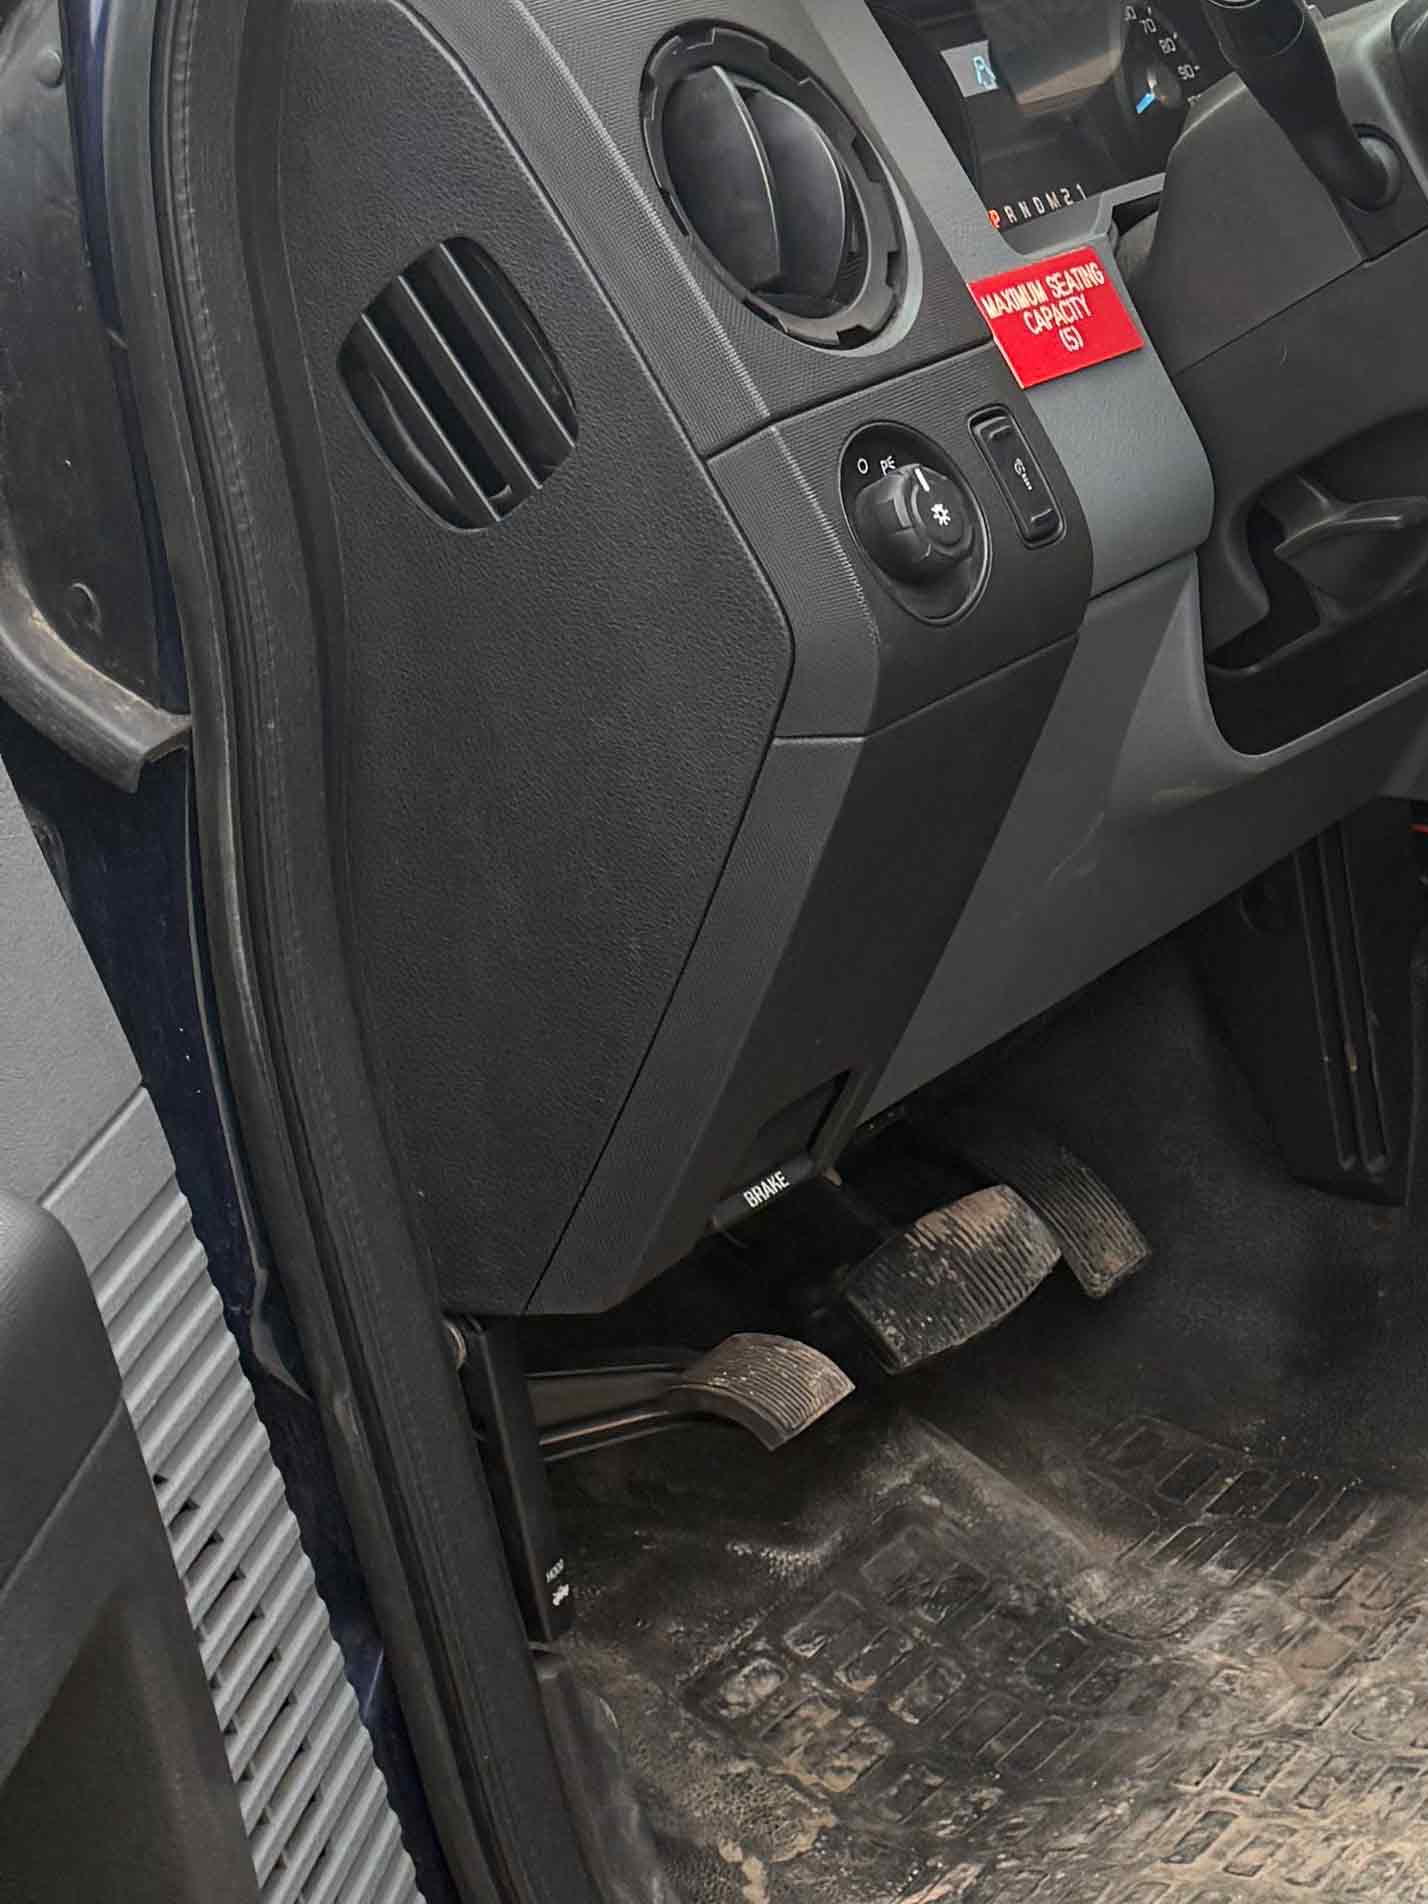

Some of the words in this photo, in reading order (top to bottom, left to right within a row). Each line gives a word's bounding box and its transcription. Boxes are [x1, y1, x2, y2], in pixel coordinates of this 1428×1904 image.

[1140, 17, 1157, 34] 70
[1159, 37, 1177, 55] 80
[1177, 63, 1195, 81] 90
[1002, 205, 1018, 224] R
[1018, 200, 1032, 219] N
[1045, 191, 1062, 211] M
[1060, 187, 1075, 206] 2
[1076, 183, 1088, 201] 1
[980, 278, 1049, 320] MAXIMUM
[1045, 261, 1105, 300] SEATING
[1022, 293, 1092, 336] CAPACITY
[1058, 324, 1086, 353] (5)
[743, 1170, 790, 1208] BRAKE
